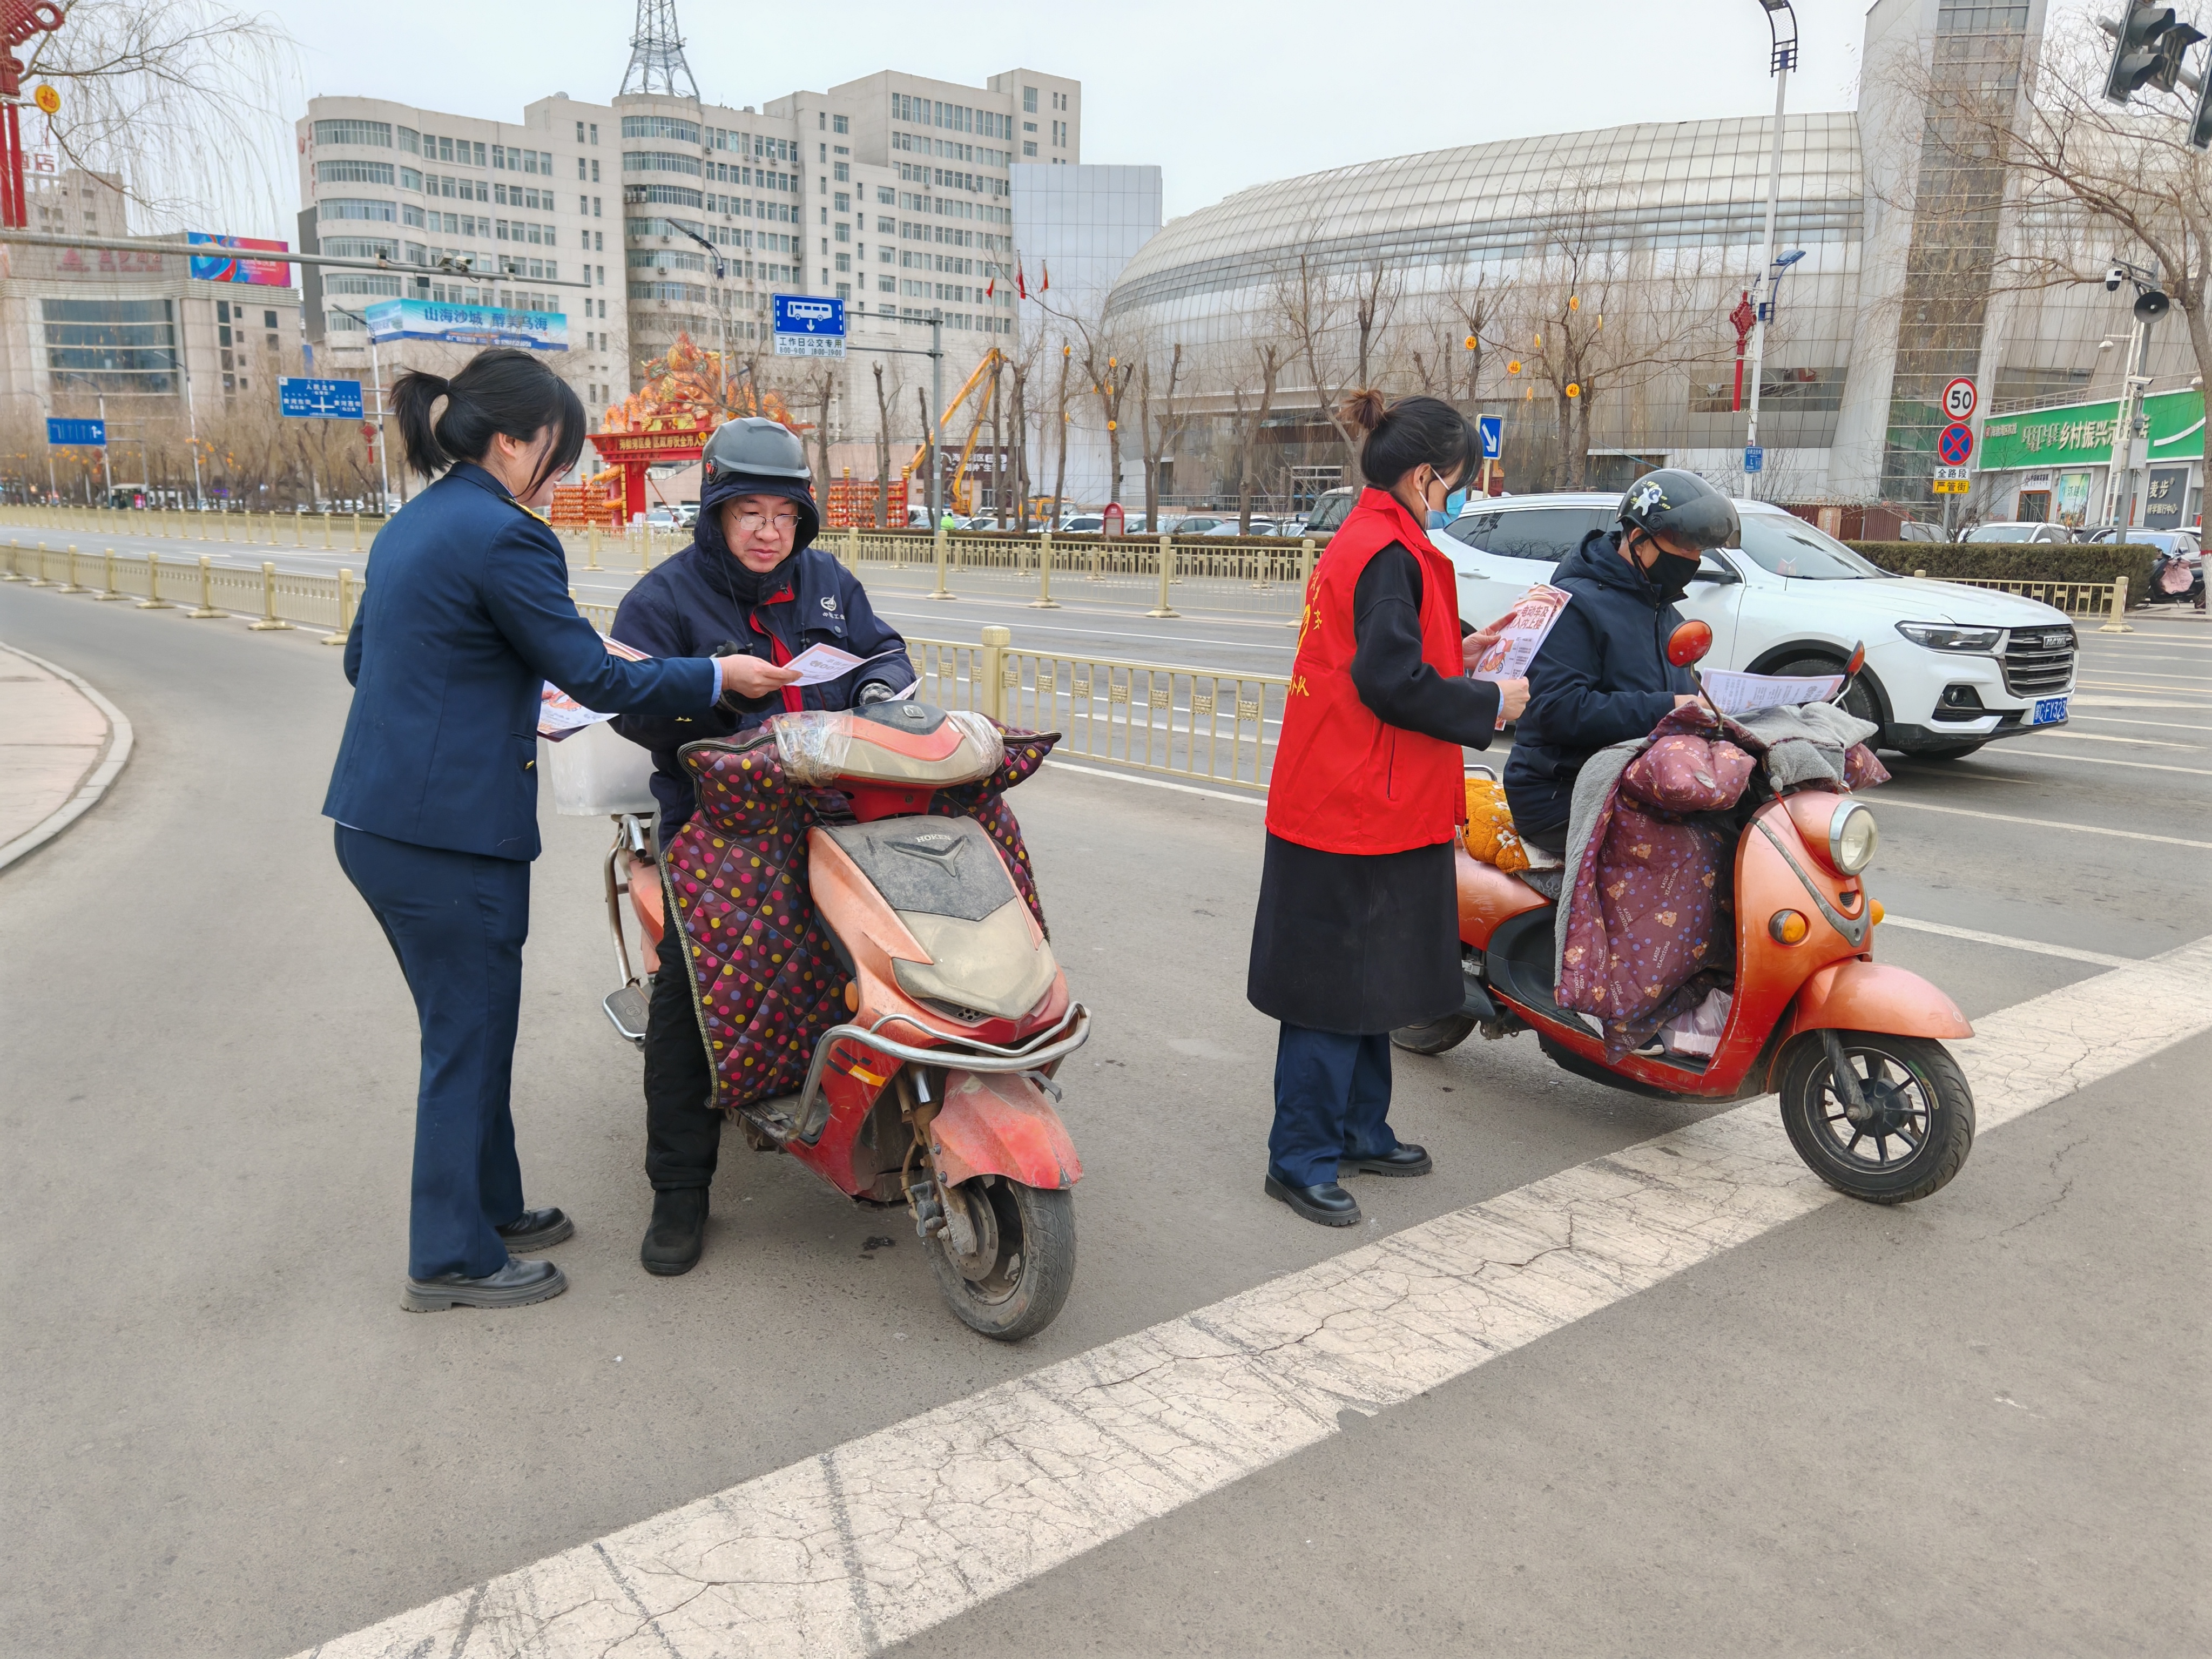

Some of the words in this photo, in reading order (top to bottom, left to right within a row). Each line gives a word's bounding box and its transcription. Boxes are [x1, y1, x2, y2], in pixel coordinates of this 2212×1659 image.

[424, 307, 483, 326] 山海沙城
[492, 313, 548, 331] 醇美乌海
[779, 337, 842, 348] 工作日公交专用
[1951, 390, 1971, 409] 50
[1938, 468, 1967, 478] 全路段
[1936, 482, 1966, 491] 严管街
[2149, 480, 2169, 498] 麦步
[916, 834, 951, 842] HOKEN
[1615, 905, 1630, 933] XIAOXIONG
[1623, 908, 1634, 923] KAIDE
[1652, 946, 1662, 962] KAIDE
[1656, 941, 1670, 969] XIAOXIONG
[1614, 980, 1624, 995] KAIDE
